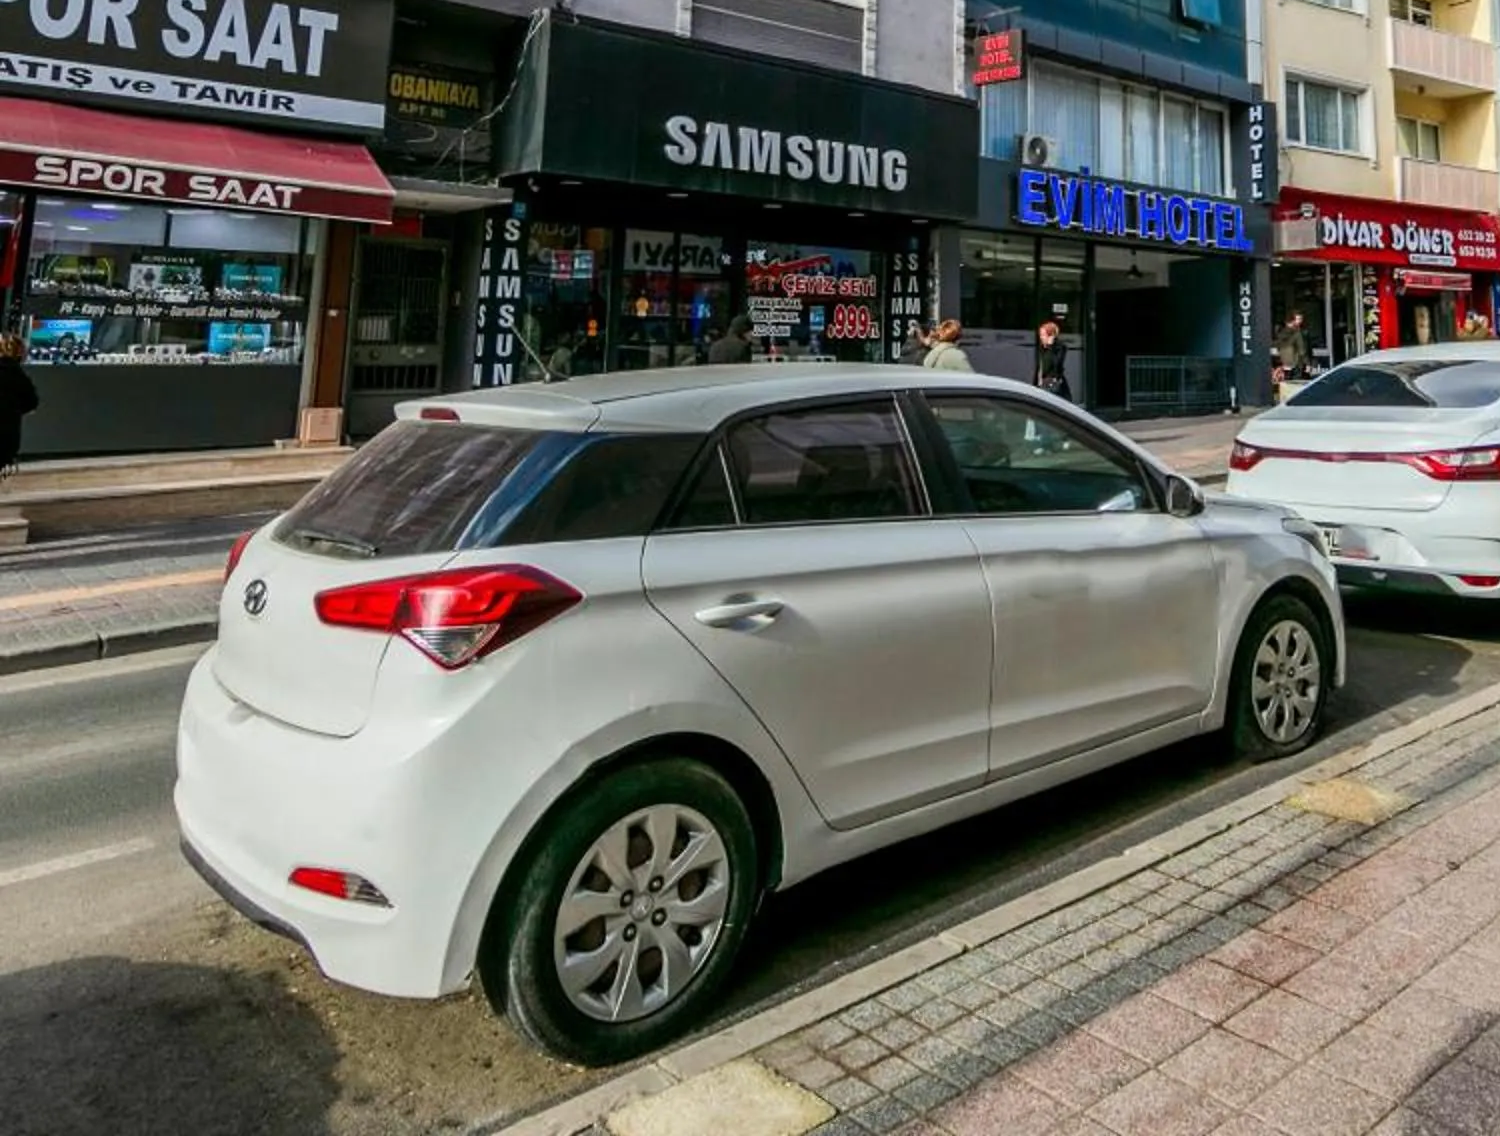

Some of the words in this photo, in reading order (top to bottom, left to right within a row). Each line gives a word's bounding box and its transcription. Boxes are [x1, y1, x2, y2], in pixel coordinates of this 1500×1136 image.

[109, 75, 156, 93] ve
[171, 80, 296, 113] TAMİR
[34, 156, 165, 196] SPOR
[188, 174, 303, 209] SAAT
[664, 115, 908, 192] SAMSUNG
[1249, 105, 1264, 200] HOTEL
[1019, 166, 1126, 237] EVİM
[1138, 189, 1254, 252] HOTEL
[1322, 213, 1385, 249] DİYAR
[1390, 220, 1456, 255] DÖNER
[1239, 281, 1253, 355] HOTEL
